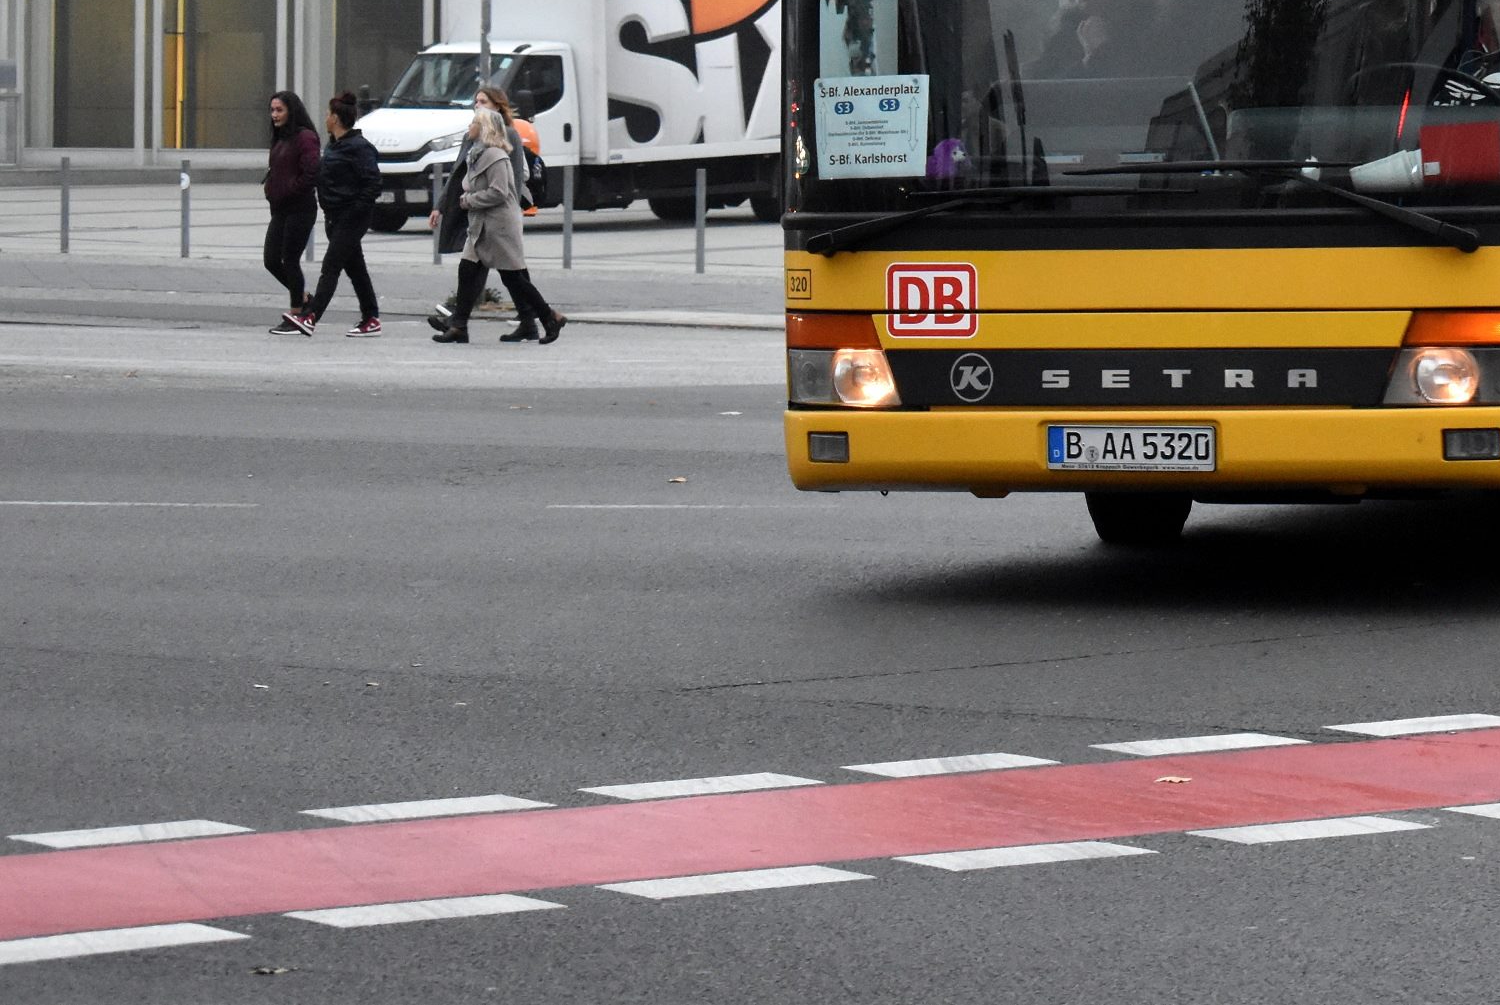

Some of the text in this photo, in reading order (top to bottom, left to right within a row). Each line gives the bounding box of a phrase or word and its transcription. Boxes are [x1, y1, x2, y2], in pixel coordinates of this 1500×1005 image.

[820, 84, 920, 98] S-Bf. Alexanderplatz
[829, 153, 907, 165] S-Bf. Karlshorst
[790, 277, 807, 292] 320
[899, 276, 965, 324] DB
[1042, 369, 1318, 389] SETRA
[1066, 432, 1083, 459] B
[1102, 432, 1135, 460] AA
[1143, 432, 1210, 461] 5320
